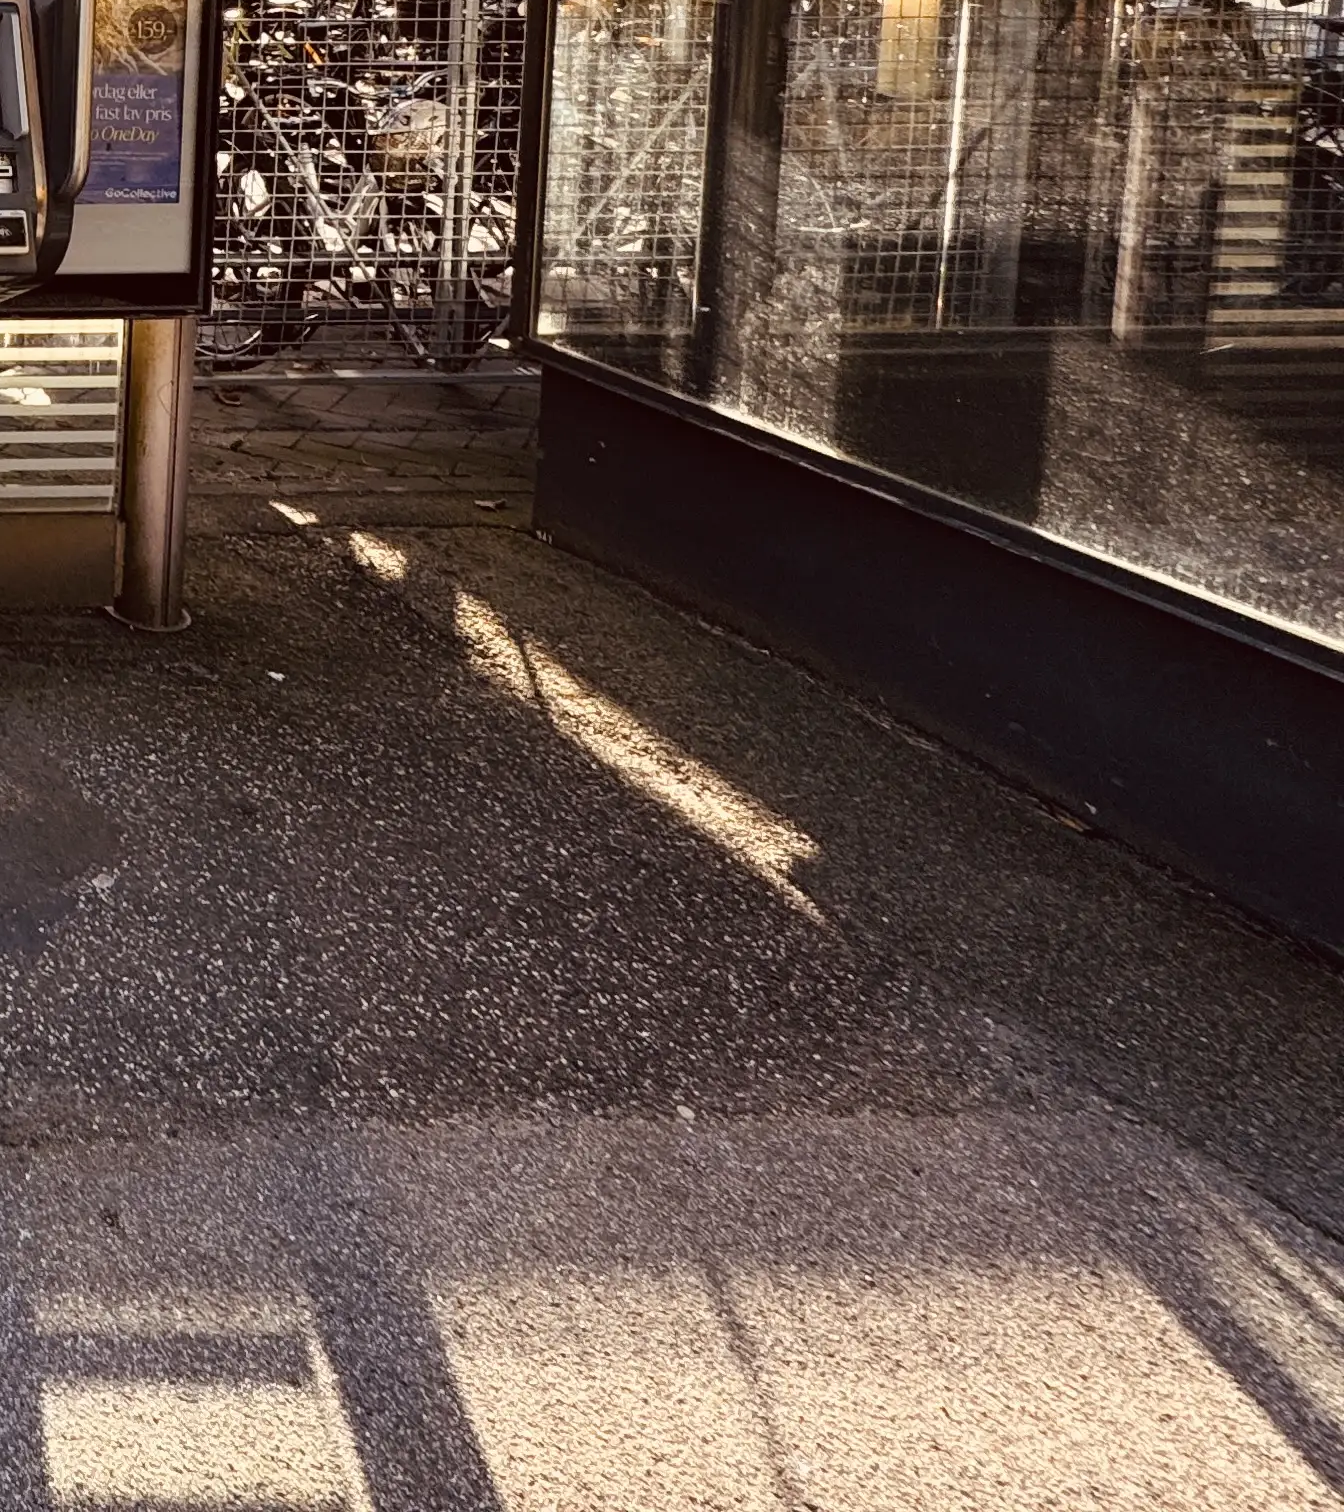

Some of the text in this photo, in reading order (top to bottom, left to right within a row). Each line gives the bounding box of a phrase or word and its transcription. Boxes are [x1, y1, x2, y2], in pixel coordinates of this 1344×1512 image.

[128, 84, 158, 99] eller
[96, 105, 173, 123] fast lav pris
[101, 125, 160, 144] OneDay
[105, 187, 178, 199] GoCollective
